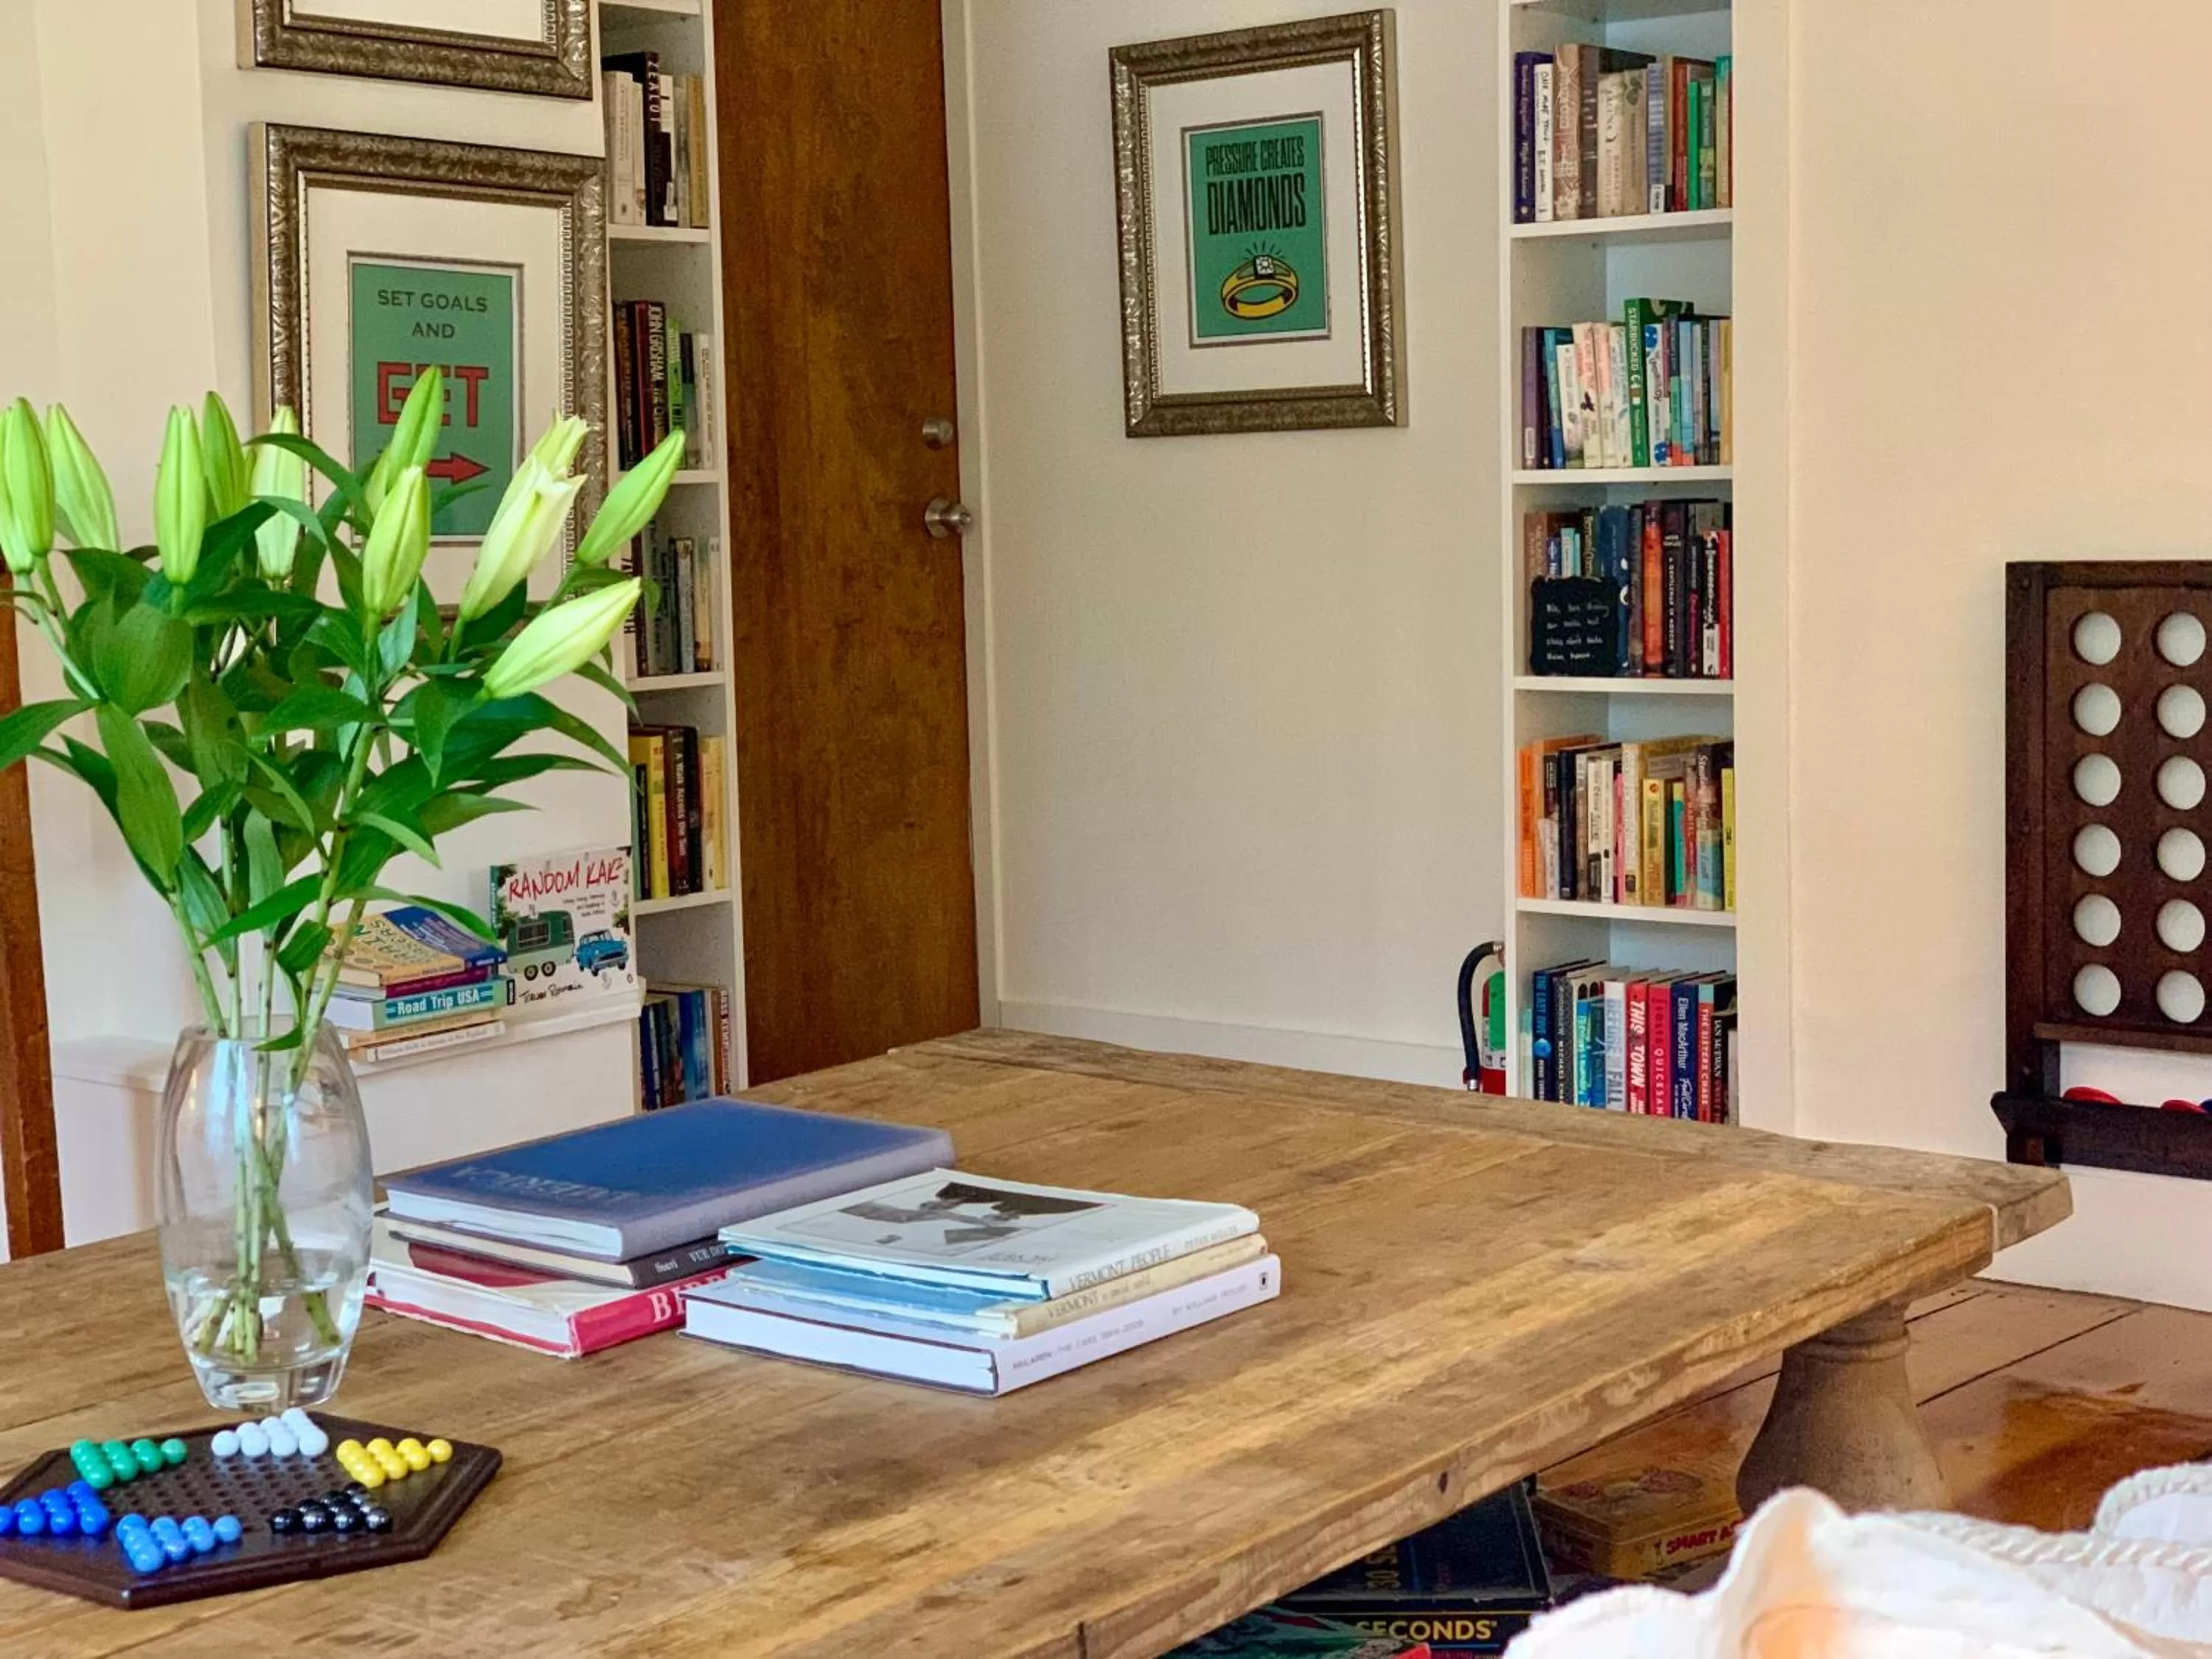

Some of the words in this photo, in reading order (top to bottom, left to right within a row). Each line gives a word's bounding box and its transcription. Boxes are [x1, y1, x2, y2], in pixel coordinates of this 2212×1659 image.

[1206, 141, 1258, 178] PRESSURE
[1261, 135, 1304, 173] CREATES
[1207, 173, 1306, 236] DIAMONDS
[377, 288, 414, 307] SET
[420, 292, 487, 313] GOALS
[412, 321, 455, 338] AND
[648, 305, 664, 333] JOHN
[1628, 307, 1639, 371] STARBUCKED
[649, 334, 664, 381] GRISHAM
[509, 860, 580, 902] RANDOM
[397, 998, 427, 1015] Road
[431, 994, 453, 1010] Trip
[456, 990, 480, 1004] USA
[1630, 1001, 1645, 1034] THIS
[1677, 997, 1688, 1020] Ellen
[1714, 1020, 1722, 1037] IAN
[1677, 1022, 1688, 1070] MacArthur
[1631, 1045, 1645, 1088] TOWN
[1607, 1071, 1623, 1104] FALL
[1068, 1259, 1124, 1290] VERMONT
[1130, 1244, 1172, 1270] PEOPLE
[1046, 1290, 1099, 1318] VERMONT
[1666, 1528, 1718, 1554] SMART
